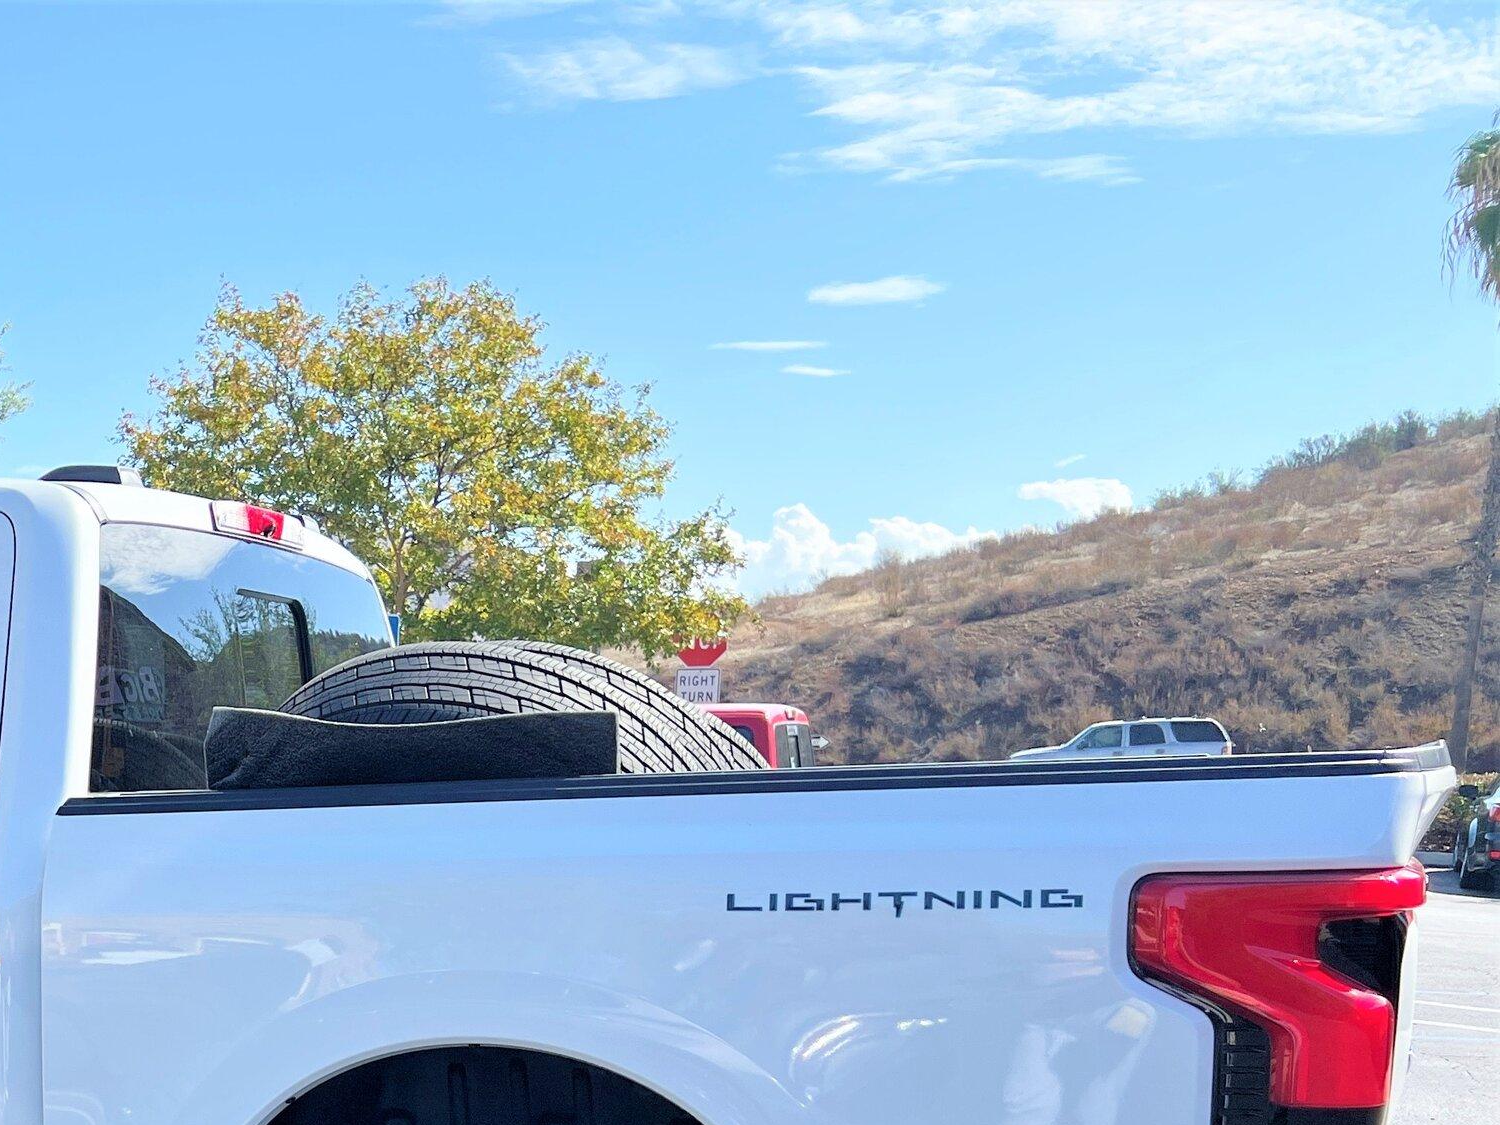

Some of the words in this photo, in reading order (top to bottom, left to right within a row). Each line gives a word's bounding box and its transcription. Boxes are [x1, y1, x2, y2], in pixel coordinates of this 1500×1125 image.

[679, 675, 716, 687] RIGHT
[680, 691, 713, 703] TURN
[726, 888, 1084, 918] LIGHTNING
